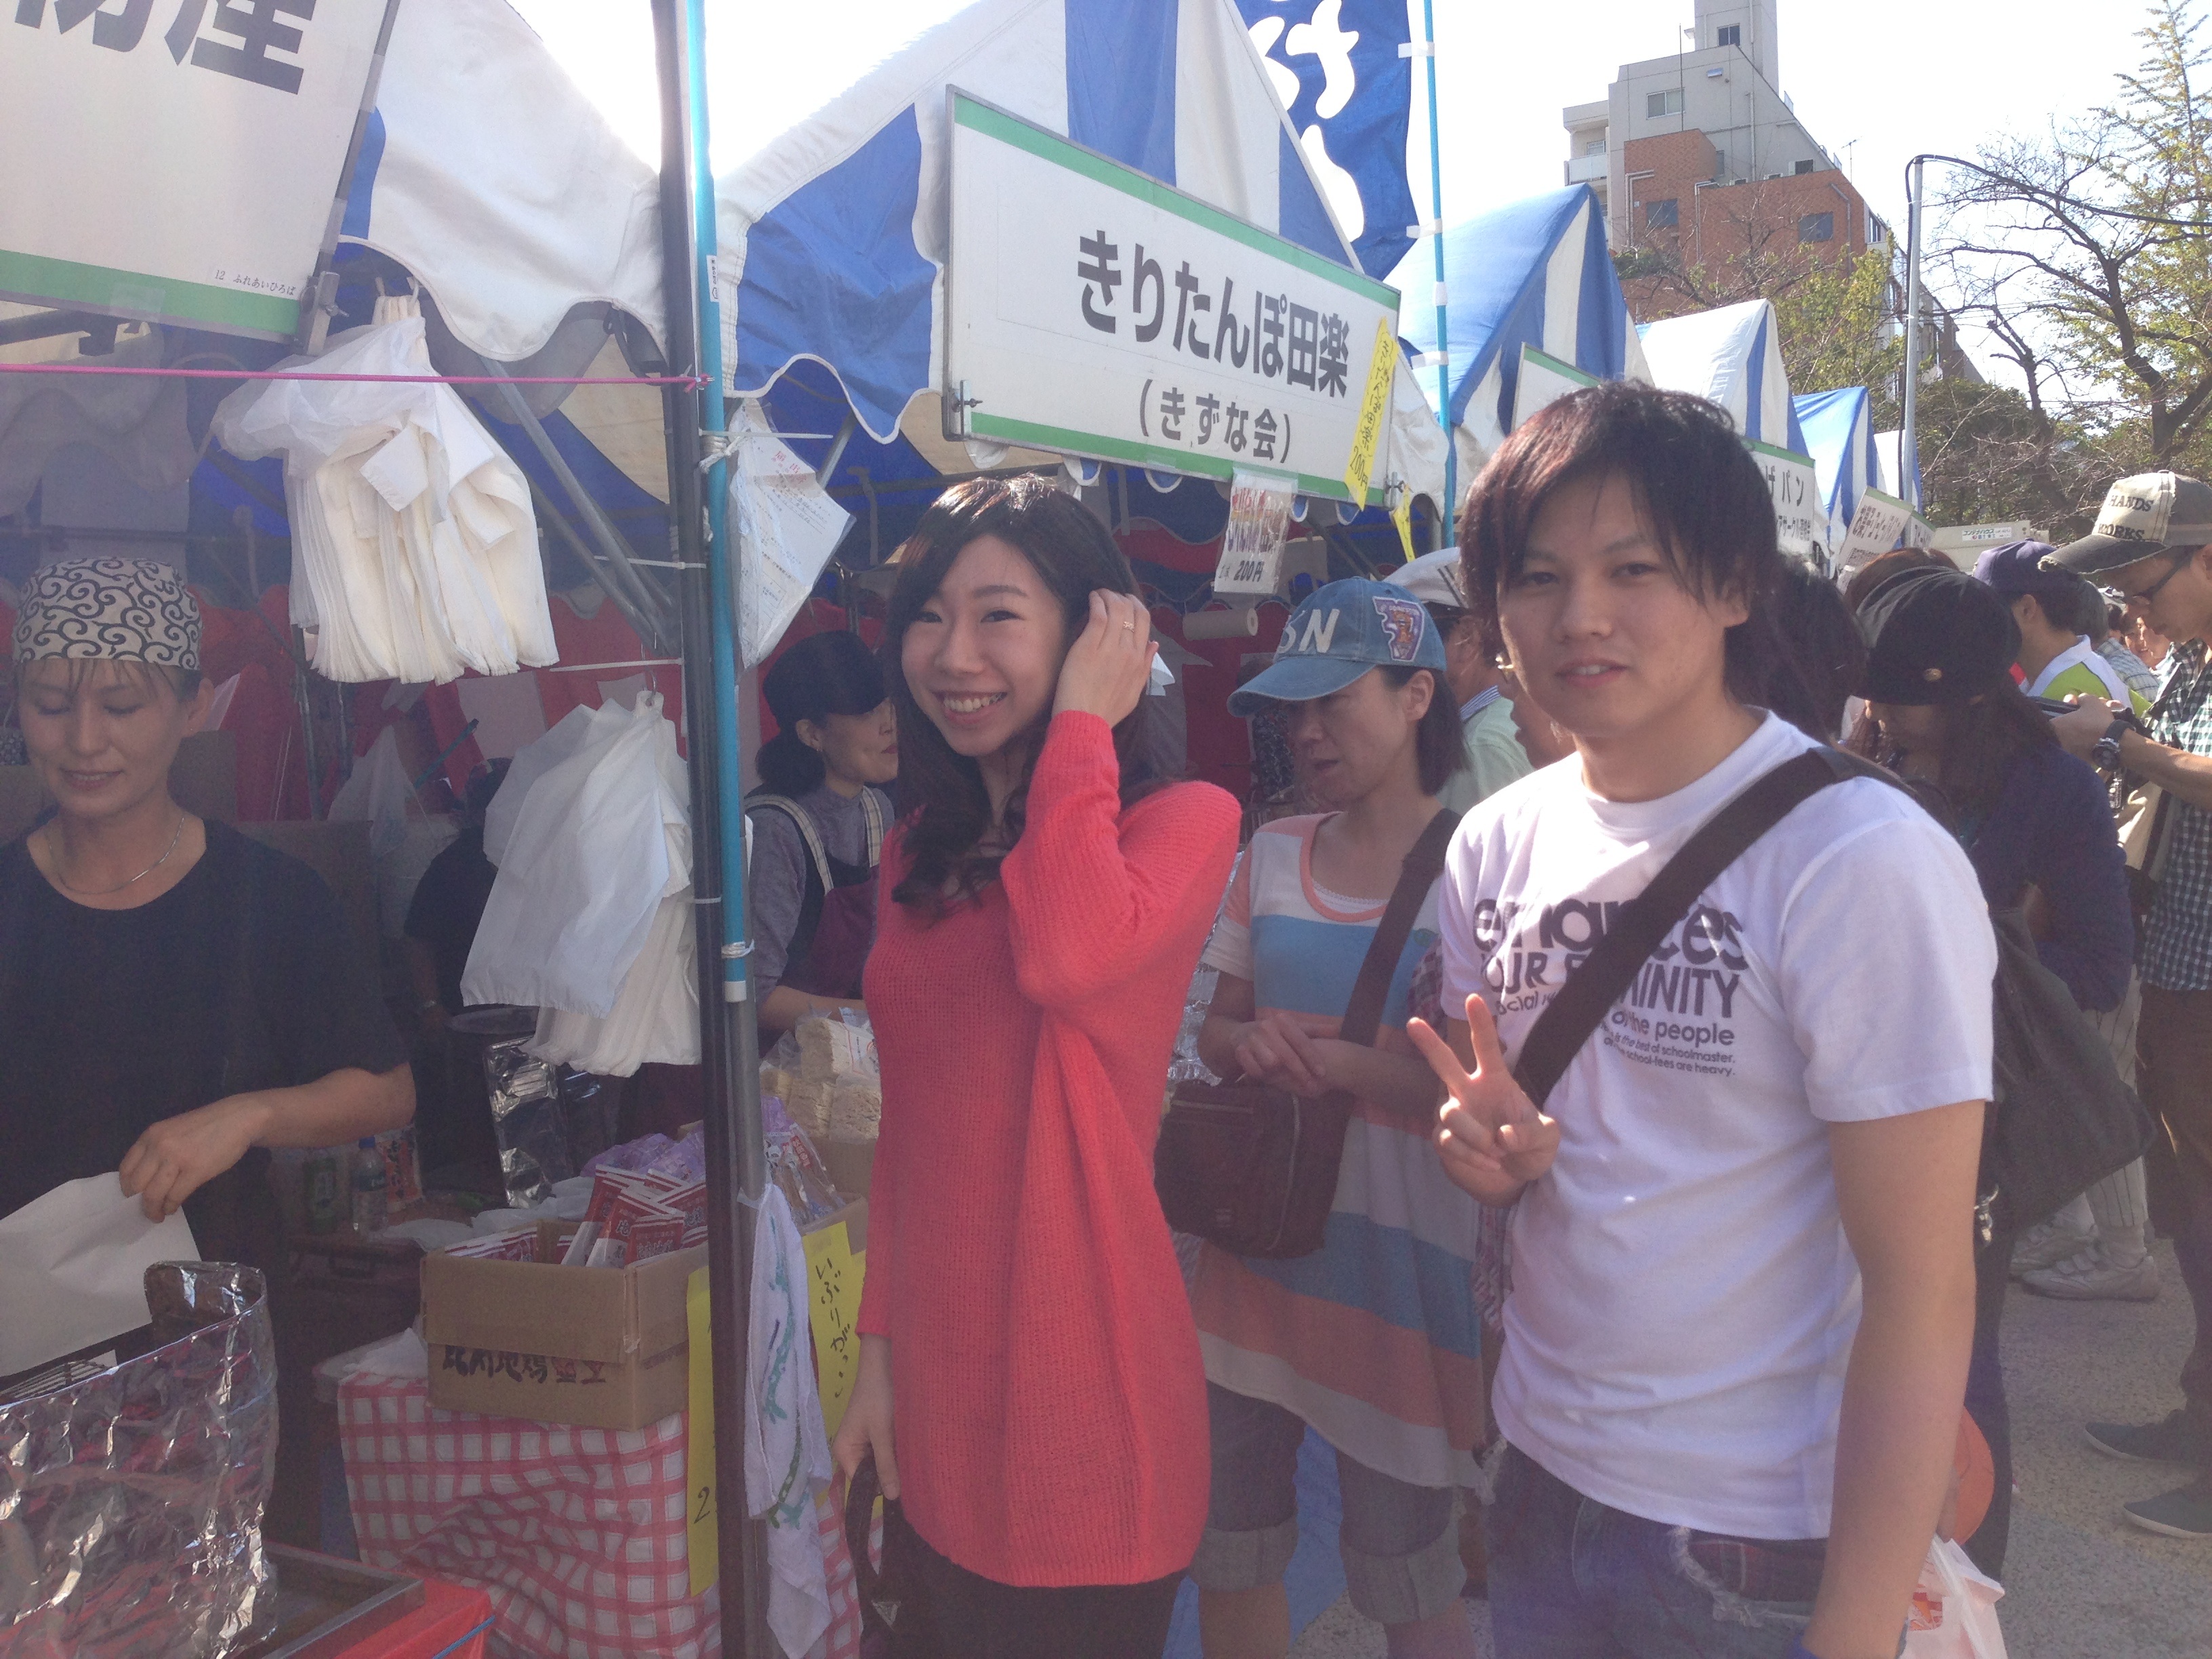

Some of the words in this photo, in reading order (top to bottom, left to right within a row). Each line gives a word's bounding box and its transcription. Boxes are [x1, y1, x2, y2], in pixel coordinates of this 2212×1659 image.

[215, 270, 226, 280] 12
[232, 274, 297, 295] ふれあいひろば
[1078, 230, 1349, 398] きりたんぽ田楽
[1233, 560, 1265, 583] 200円
[1655, 1022, 1736, 1048] people
[1662, 1046, 1736, 1064] schoolmaster.
[1676, 1061, 1693, 1072] are
[1695, 1063, 1736, 1078] heavy.
